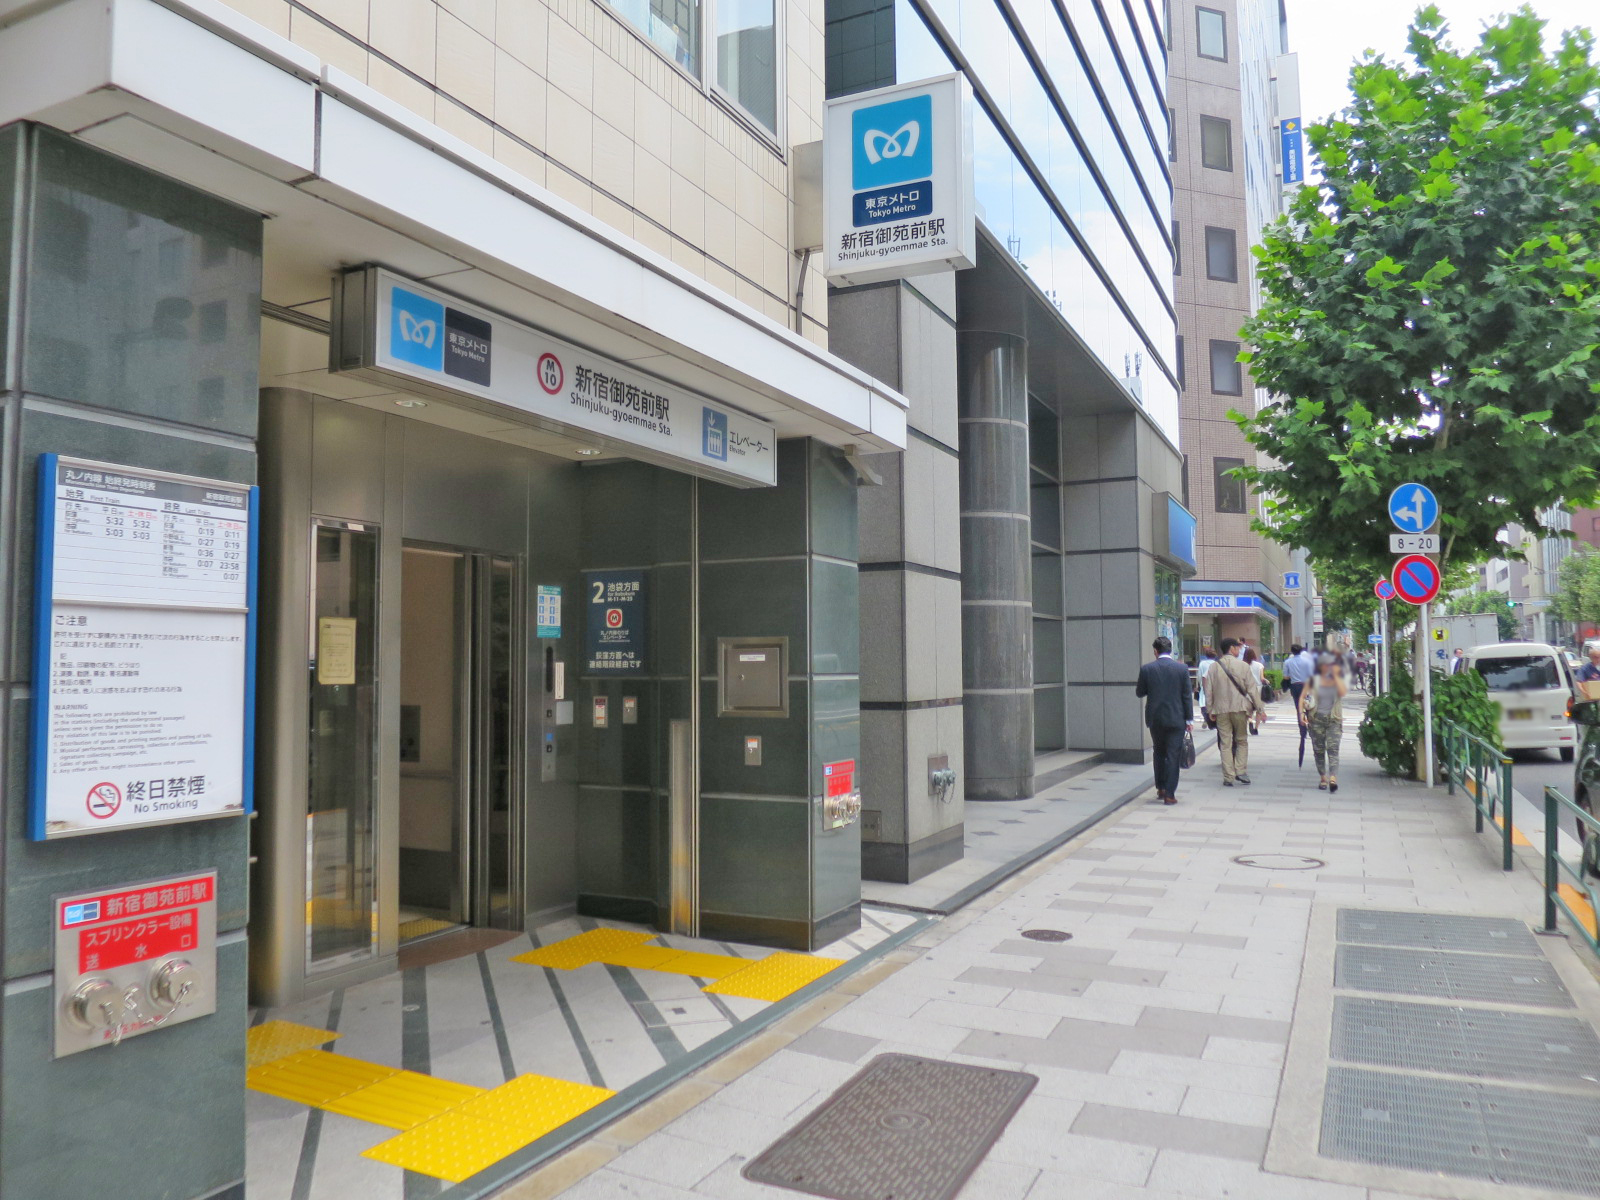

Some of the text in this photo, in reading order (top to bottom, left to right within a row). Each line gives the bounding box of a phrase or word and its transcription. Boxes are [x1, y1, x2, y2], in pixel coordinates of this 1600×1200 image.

[866, 190, 920, 210] 東京メトロ
[868, 204, 916, 218] Tokyo Metro
[842, 218, 945, 250] 新宿御苑前駅
[838, 236, 948, 261] Shinjuku-gyoemmae Sta.
[449, 332, 488, 355] 東京メトロ
[451, 344, 485, 363] Tokyo Metro
[546, 359, 554, 372] M
[544, 372, 556, 386] 10
[575, 365, 670, 422] 新宿御苑前駅
[570, 391, 672, 437] Shinjuku-gyoemmae Sta.
[729, 431, 769, 453] エレベーター
[66, 489, 84, 499] 始発
[106, 516, 124, 526] 5:32
[133, 520, 150, 529] 5:32
[106, 528, 123, 537] 5:03
[133, 531, 150, 540] 5:03
[198, 528, 215, 536] 0:19
[198, 538, 214, 546] 0:27
[224, 541, 240, 549] 0:19
[198, 549, 214, 557] 0:36
[220, 562, 240, 570] 23:58
[592, 581, 604, 603] 2
[608, 582, 640, 592] 池袋方面
[1182, 596, 1230, 607] AWSON
[55, 615, 88, 626] ご注意
[126, 775, 205, 802] 終日禁煙
[134, 798, 198, 814] No Smoking
[106, 882, 207, 916] 新宿御苑前駅
[86, 913, 192, 948] スプリンクラー設備
[86, 953, 99, 970] 送
[135, 943, 147, 959] 水
